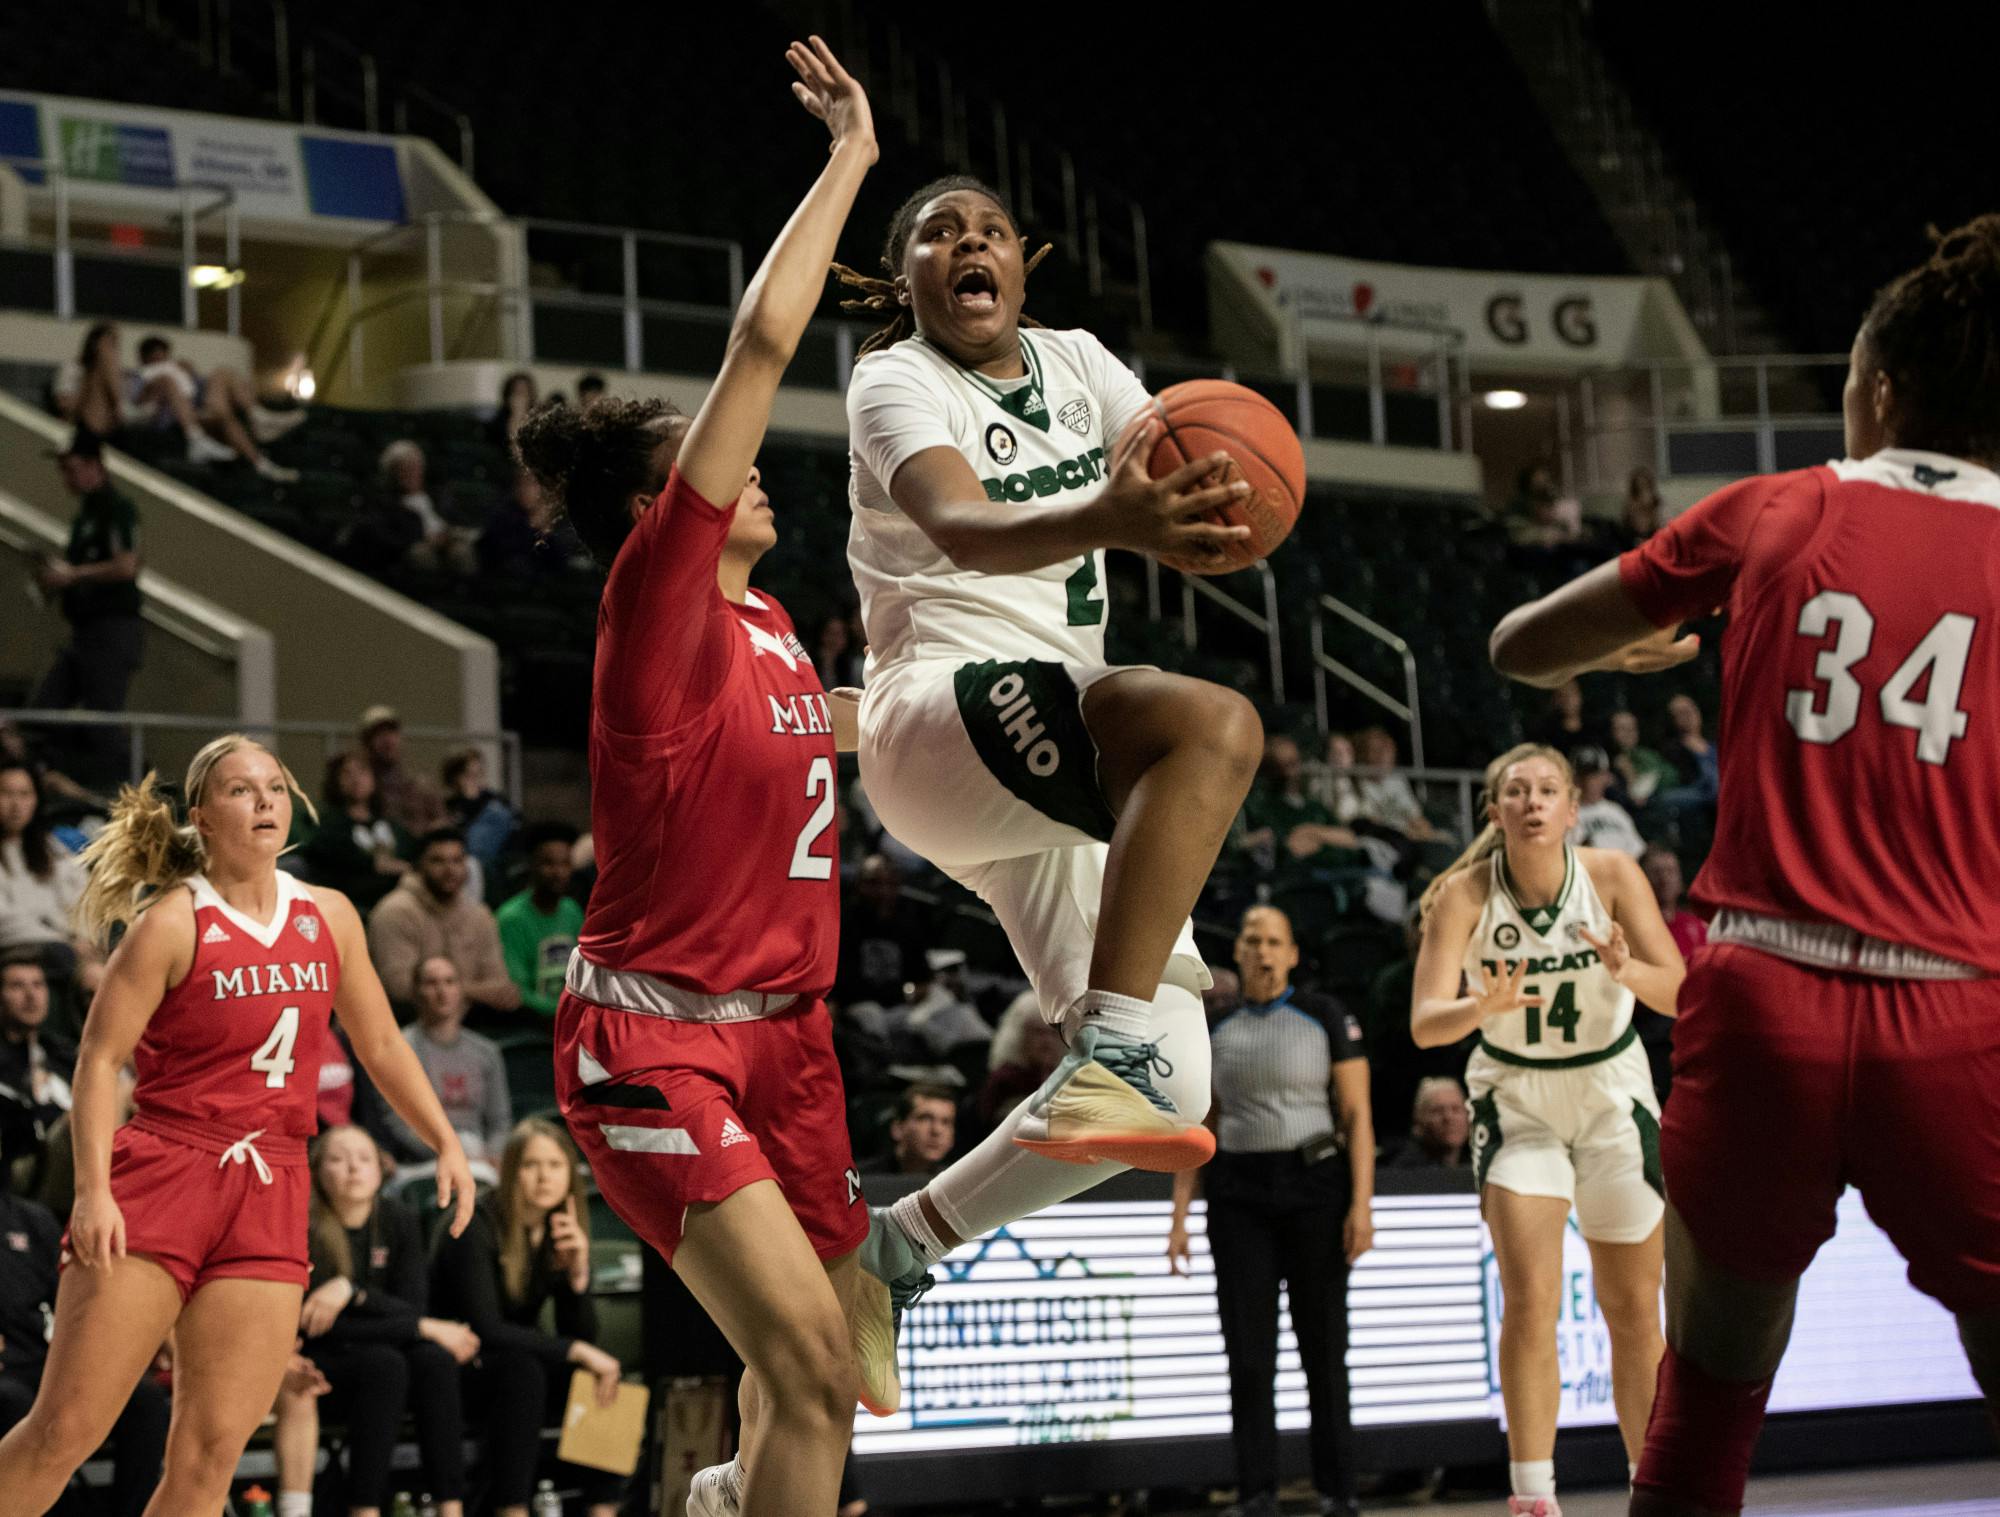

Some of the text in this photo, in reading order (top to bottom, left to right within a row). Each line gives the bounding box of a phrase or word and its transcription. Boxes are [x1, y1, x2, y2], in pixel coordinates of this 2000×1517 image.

[981, 446, 1110, 504] BOBCAT
[1064, 548, 1105, 627] 2
[1784, 588, 1978, 767] 34
[988, 672, 1060, 778] OHIO
[787, 755, 836, 881] 2
[210, 961, 330, 1001] MIAMI
[1523, 981, 1582, 1046] 14
[250, 1006, 300, 1089] 4
